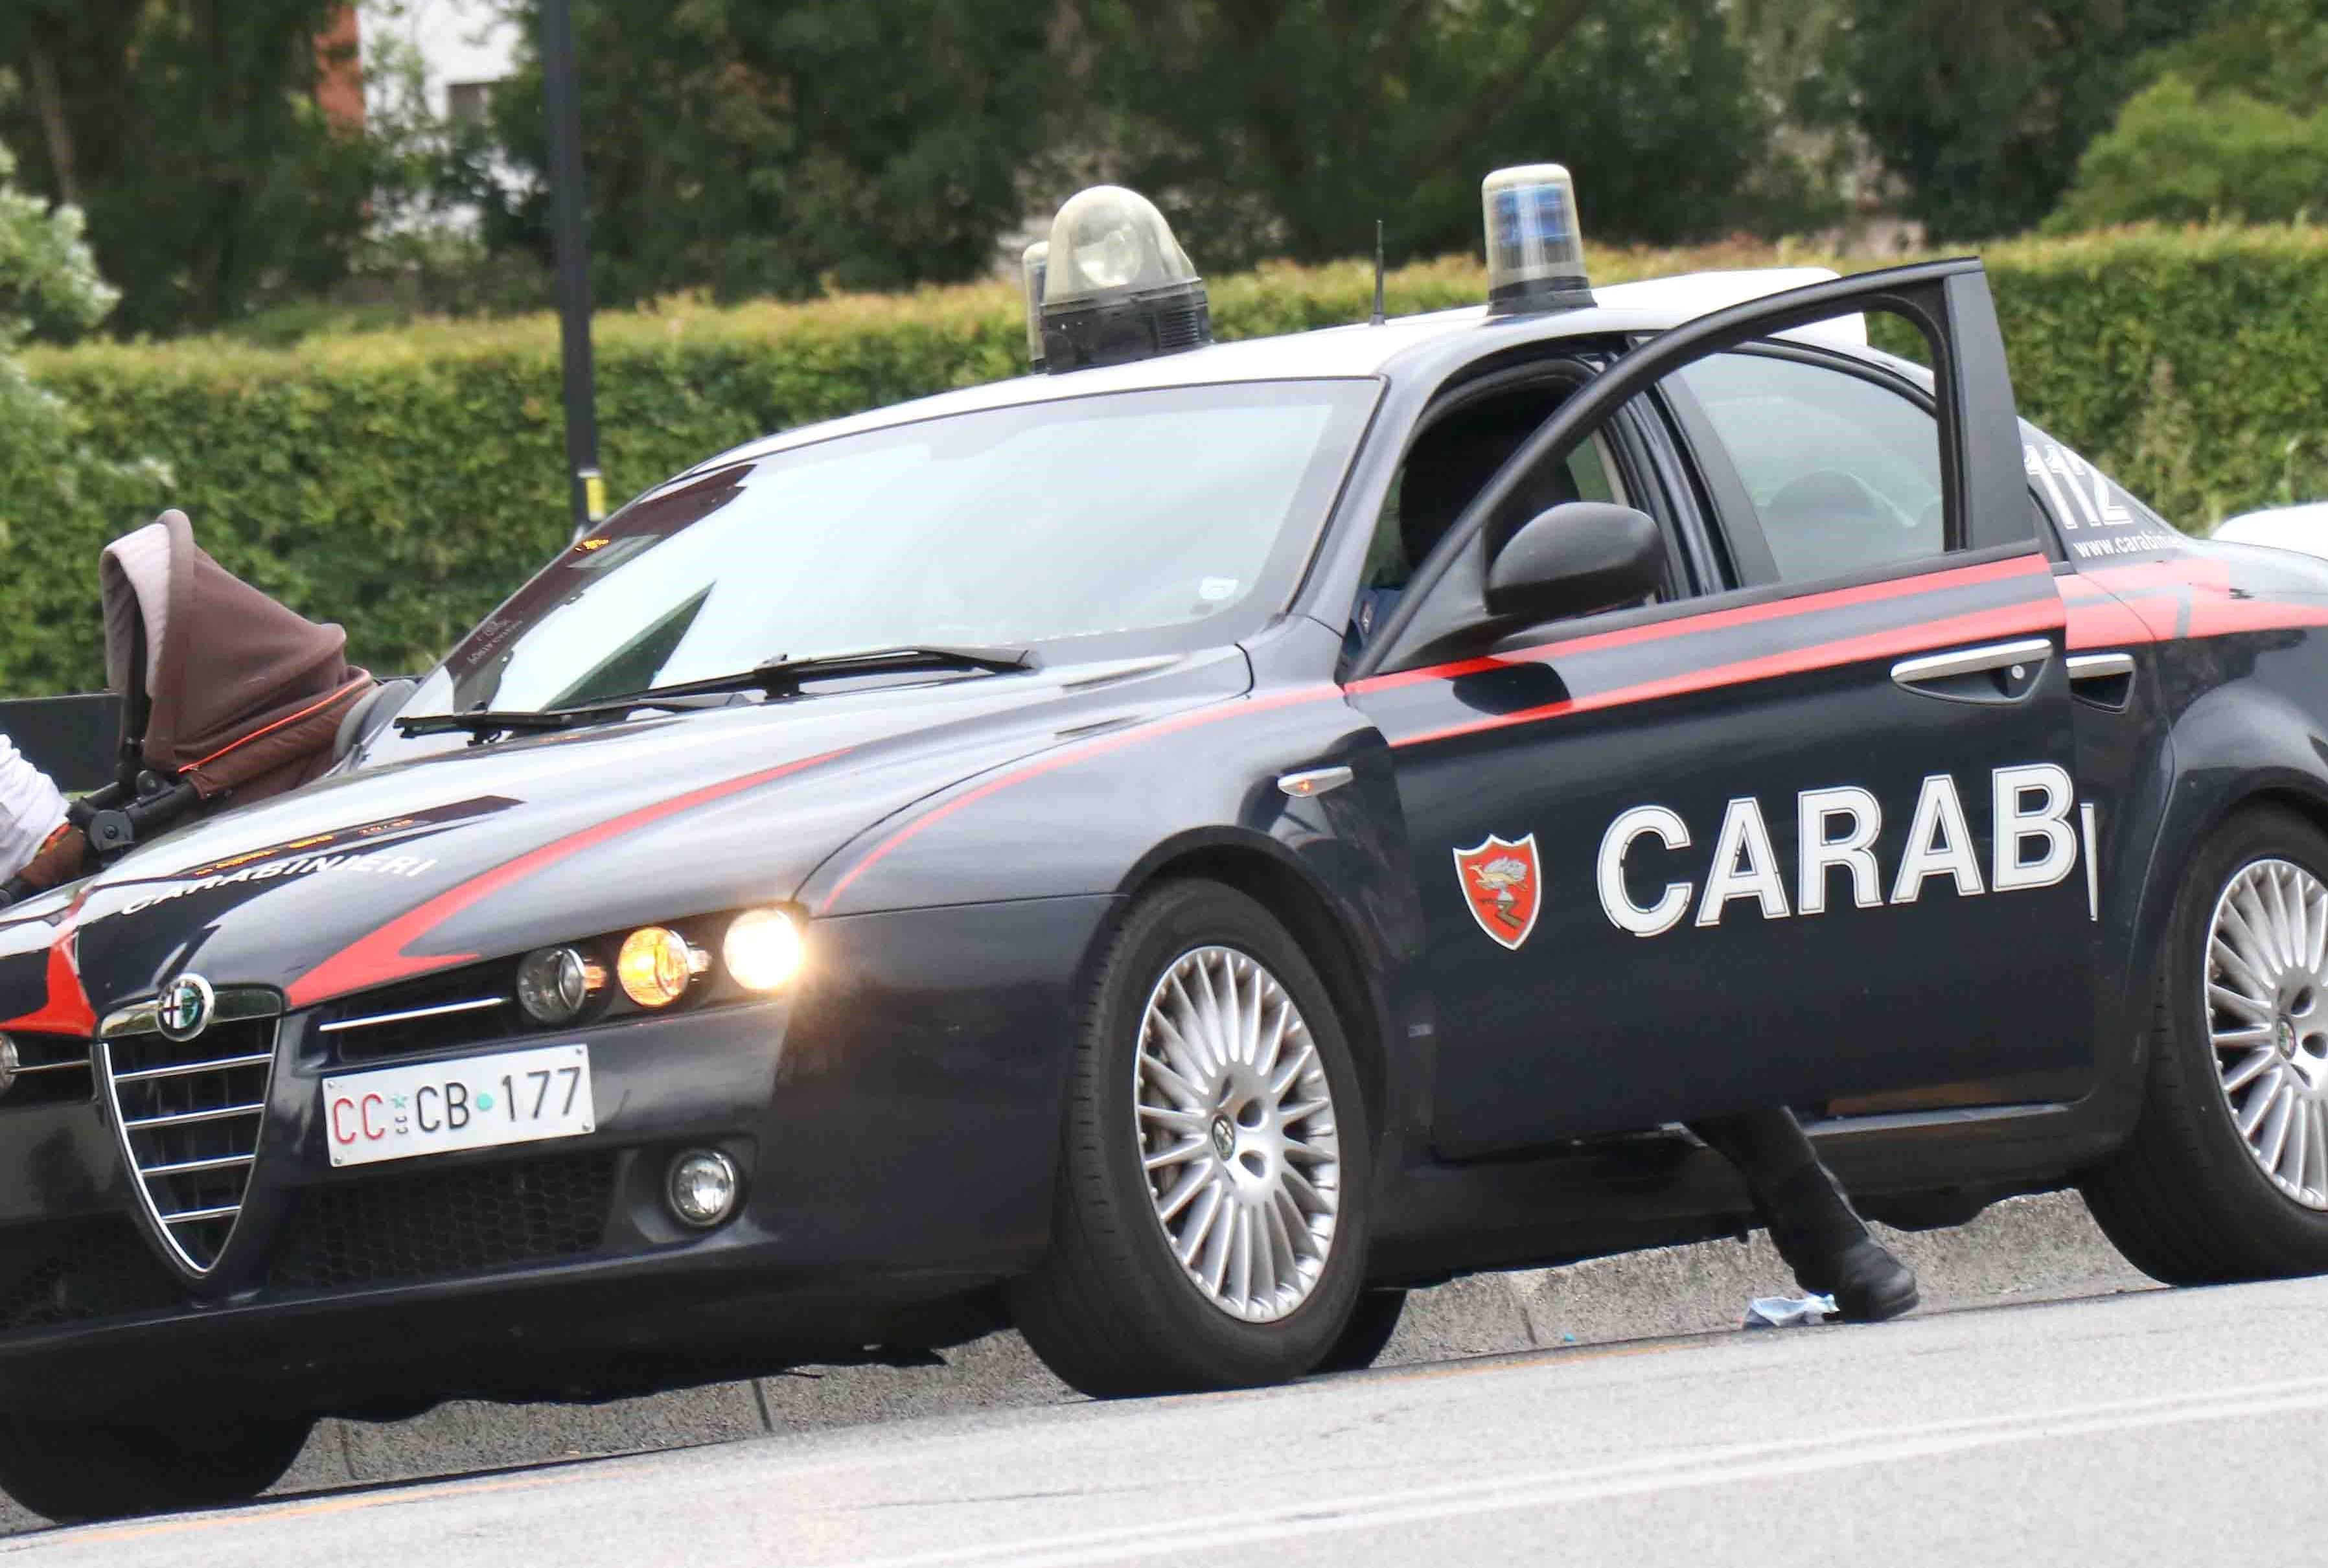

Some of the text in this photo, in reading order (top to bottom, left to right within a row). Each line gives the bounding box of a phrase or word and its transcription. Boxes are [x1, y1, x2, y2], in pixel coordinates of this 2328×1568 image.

[2024, 444, 2134, 529] 112
[122, 856, 439, 915] CARABINIERI
[332, 1066, 582, 1145] CC CB 177
